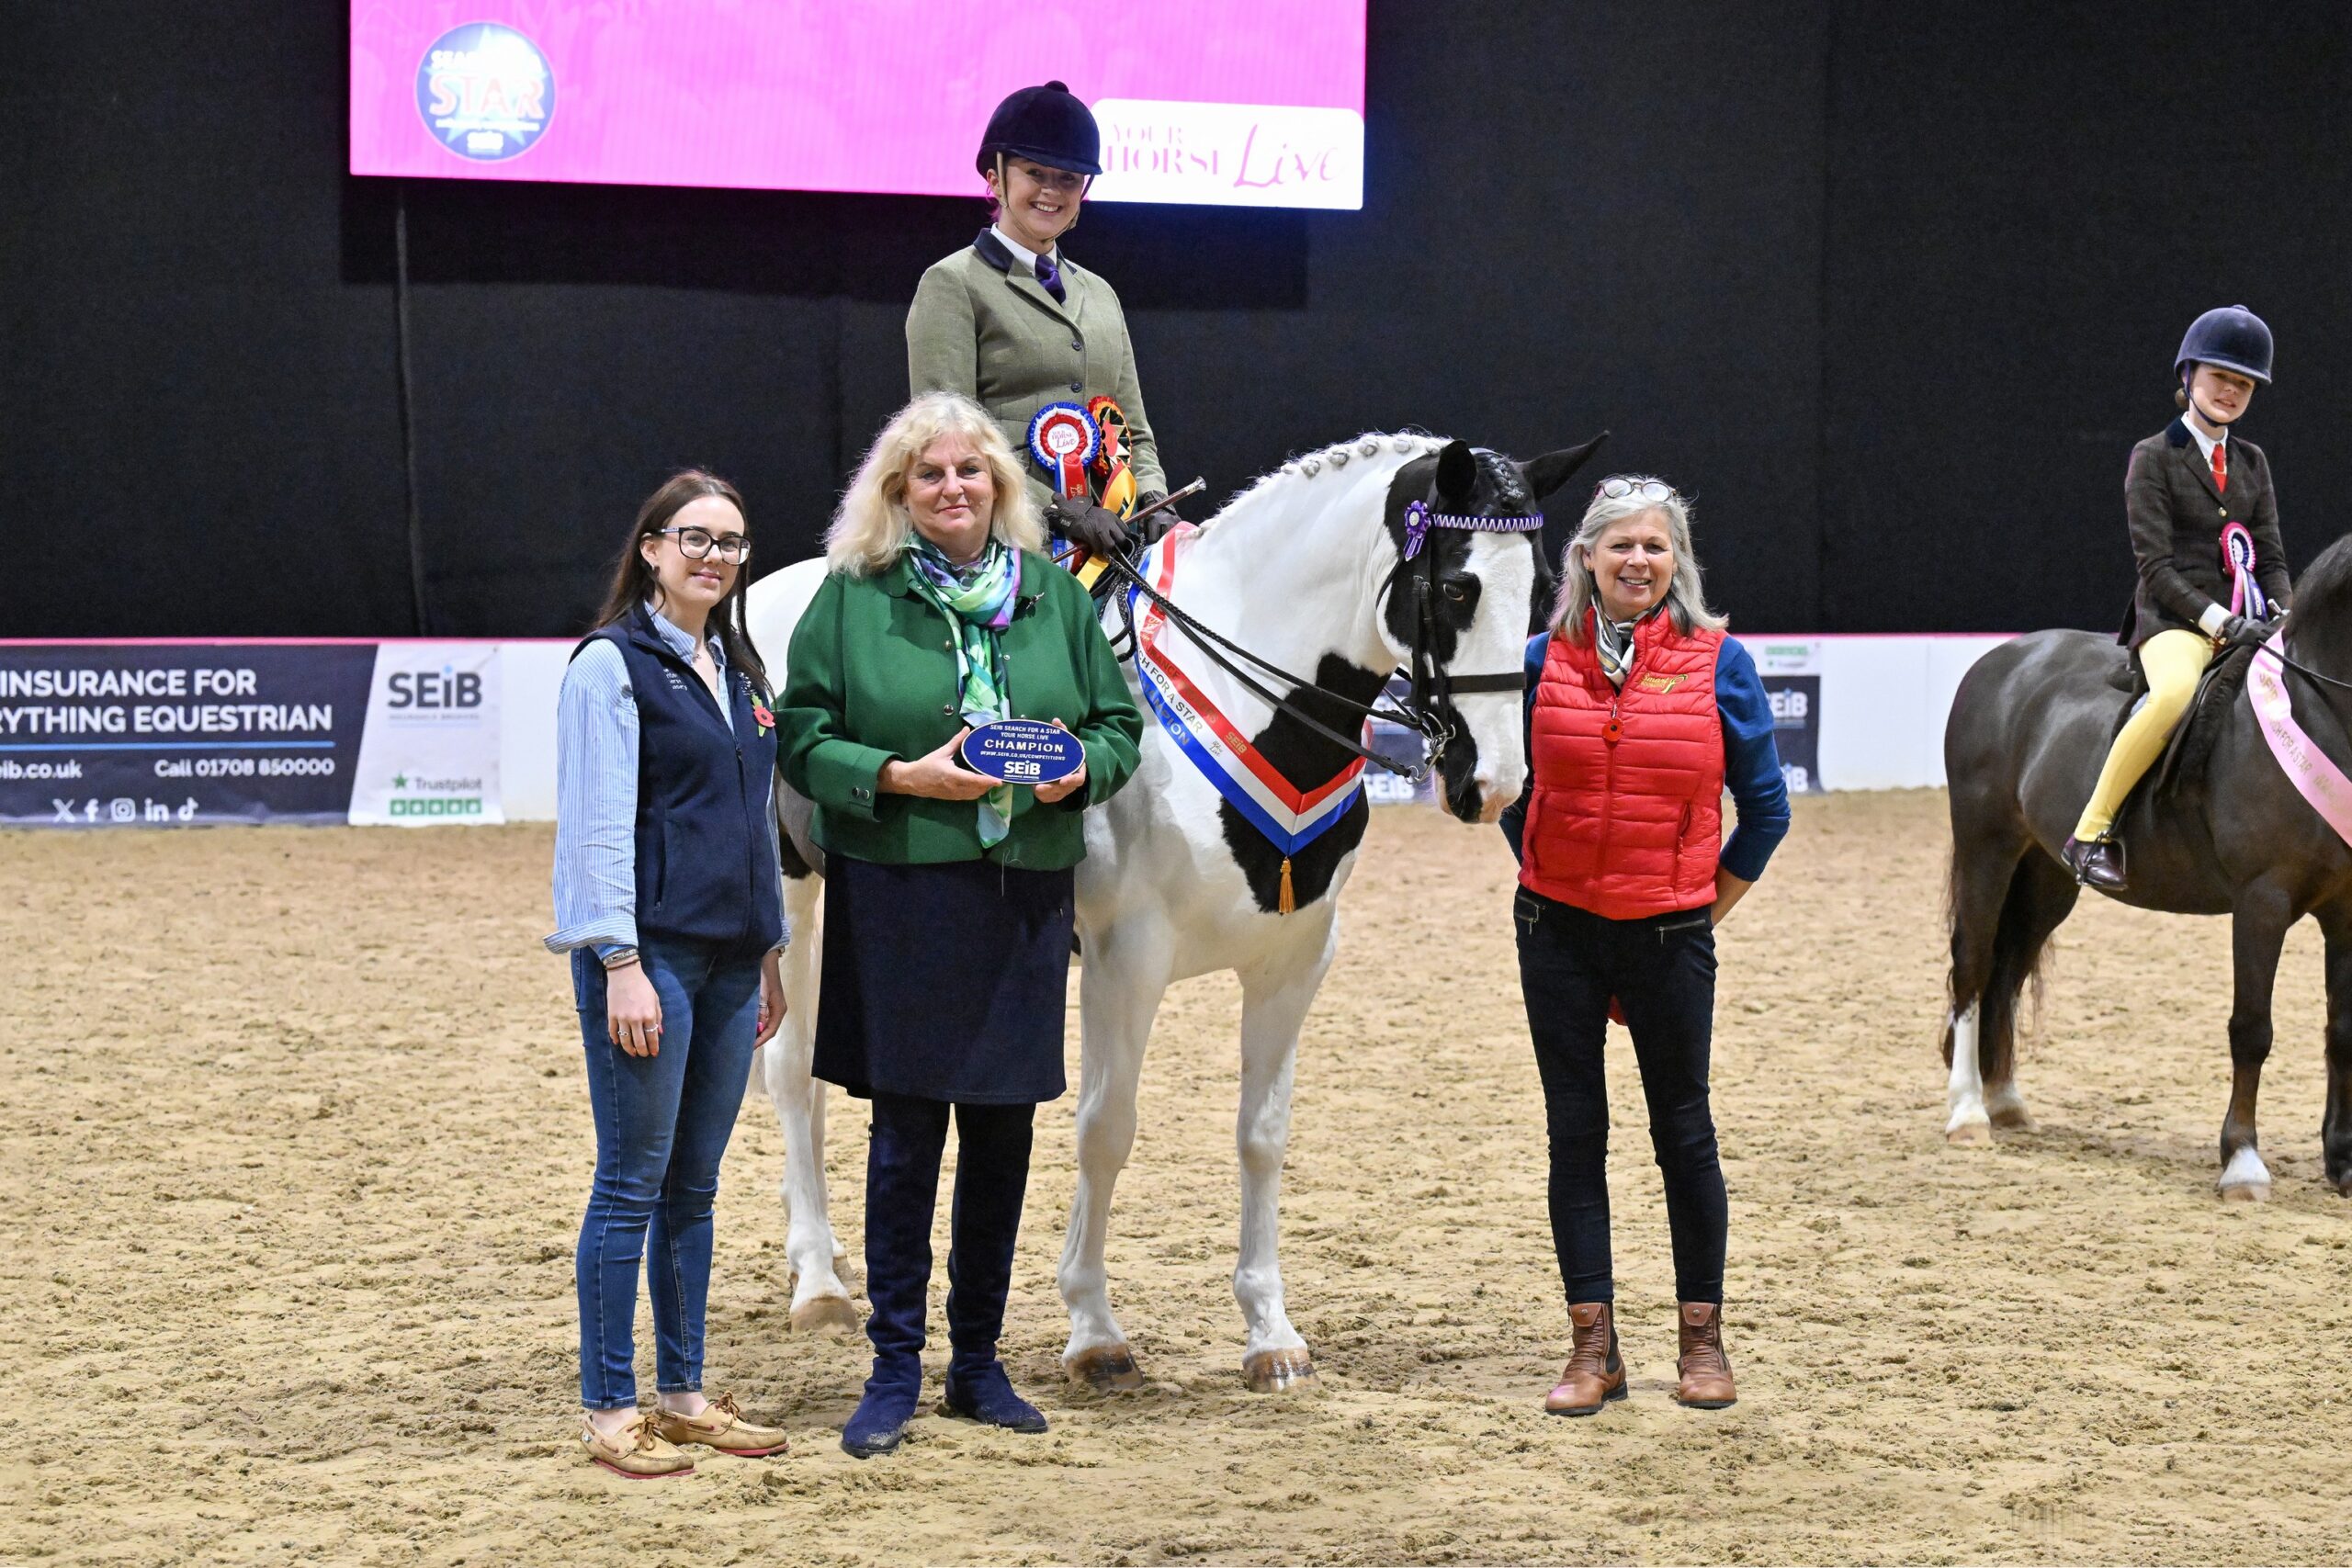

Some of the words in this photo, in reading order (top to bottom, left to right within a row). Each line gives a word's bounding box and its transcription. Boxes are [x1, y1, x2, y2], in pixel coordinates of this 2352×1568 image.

[429, 73, 546, 119] STAR
[1233, 123, 1342, 187] Live
[0, 669, 187, 697] INSURANCE
[194, 669, 256, 696] FOR
[1150, 667, 1170, 694] FOR
[1166, 692, 1176, 704] A
[1175, 701, 1204, 734] STAR
[0, 705, 127, 734] YTHING
[134, 705, 333, 733] EQUESTRIAN
[984, 739, 1064, 753] CHAMPION
[0, 759, 83, 779] ib.co.uk
[154, 760, 192, 777] Call
[196, 759, 254, 776] 01708
[258, 758, 335, 776] 850000
[2293, 750, 2313, 775] STAR
[414, 776, 482, 792] Trustpilot
